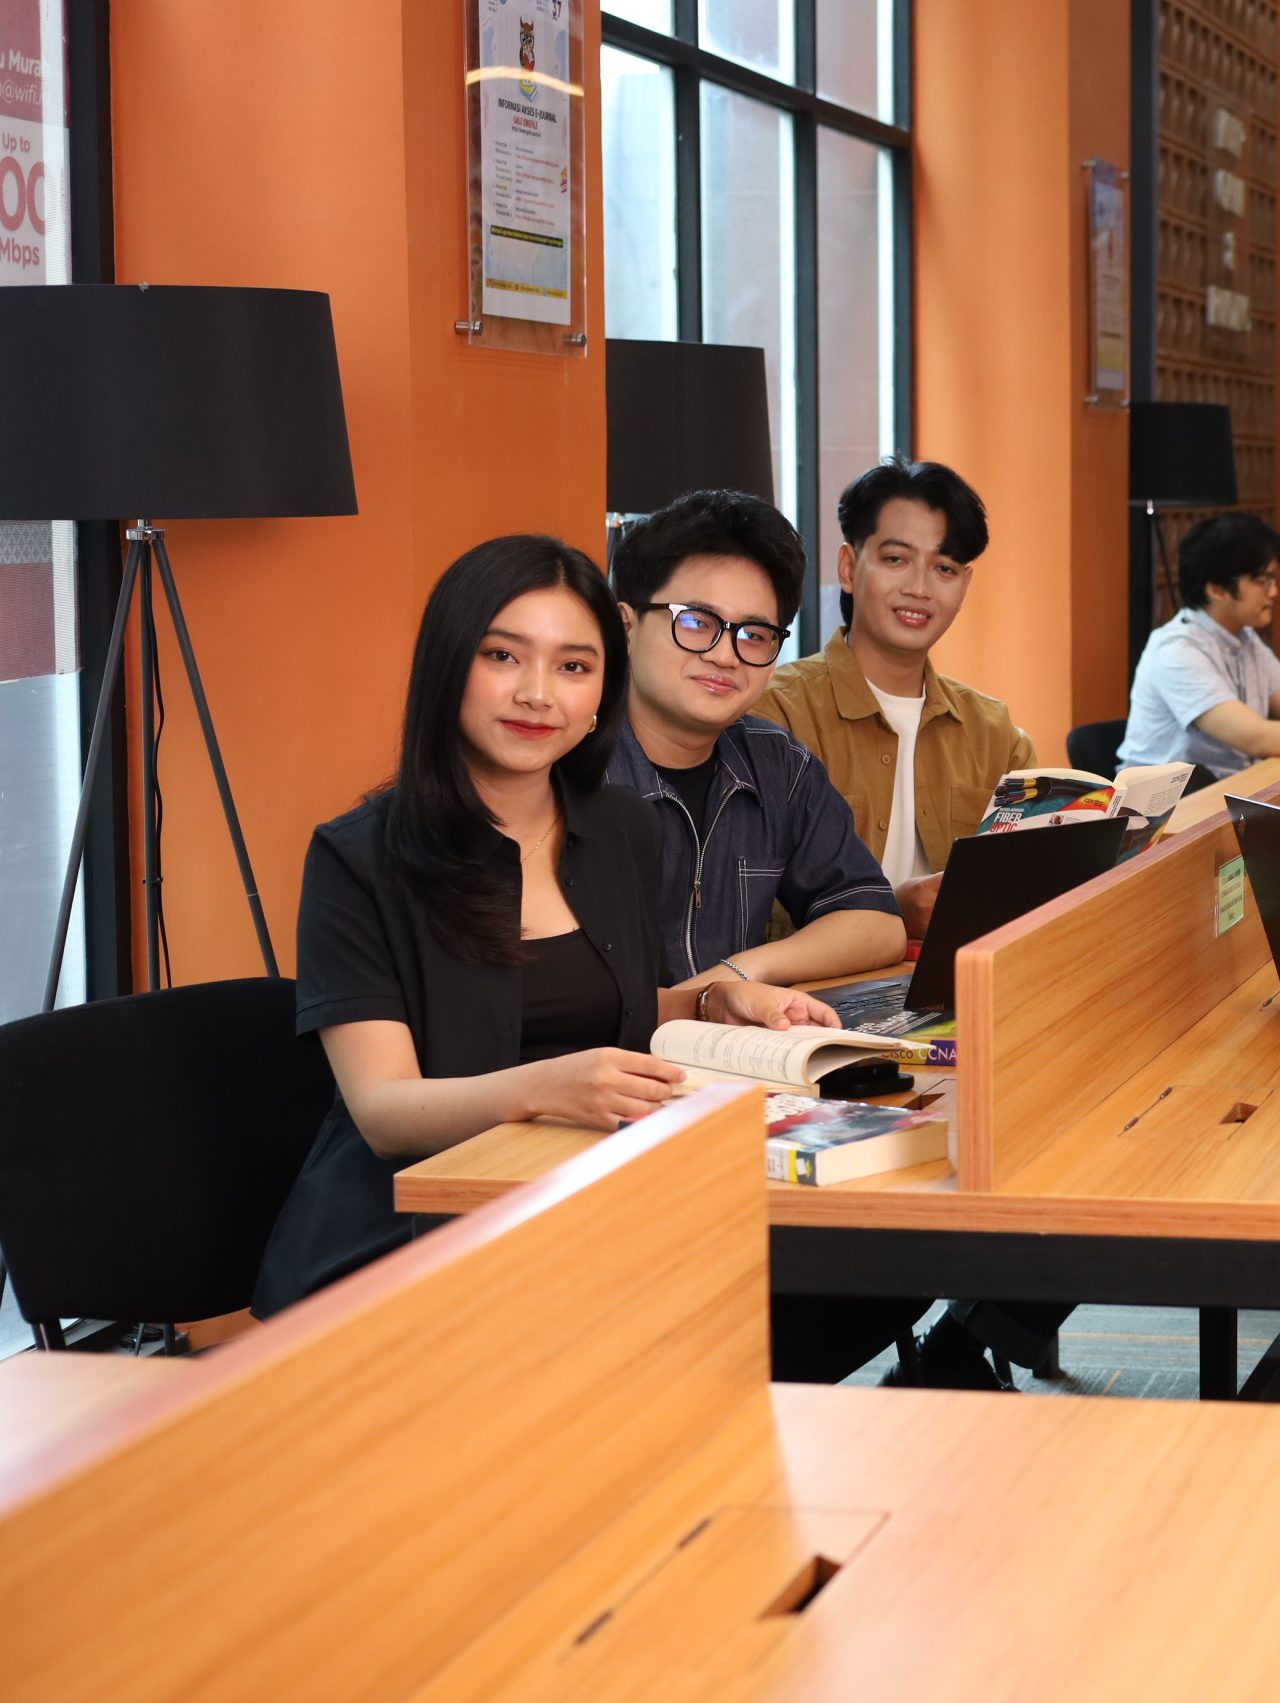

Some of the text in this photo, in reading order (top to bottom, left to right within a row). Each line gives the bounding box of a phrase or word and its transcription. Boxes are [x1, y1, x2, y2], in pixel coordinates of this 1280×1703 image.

[2, 131, 31, 153] Up to
[0, 237, 40, 270] Mbps
[994, 812, 1022, 822] FIBER
[918, 1046, 958, 1061] CCNA
